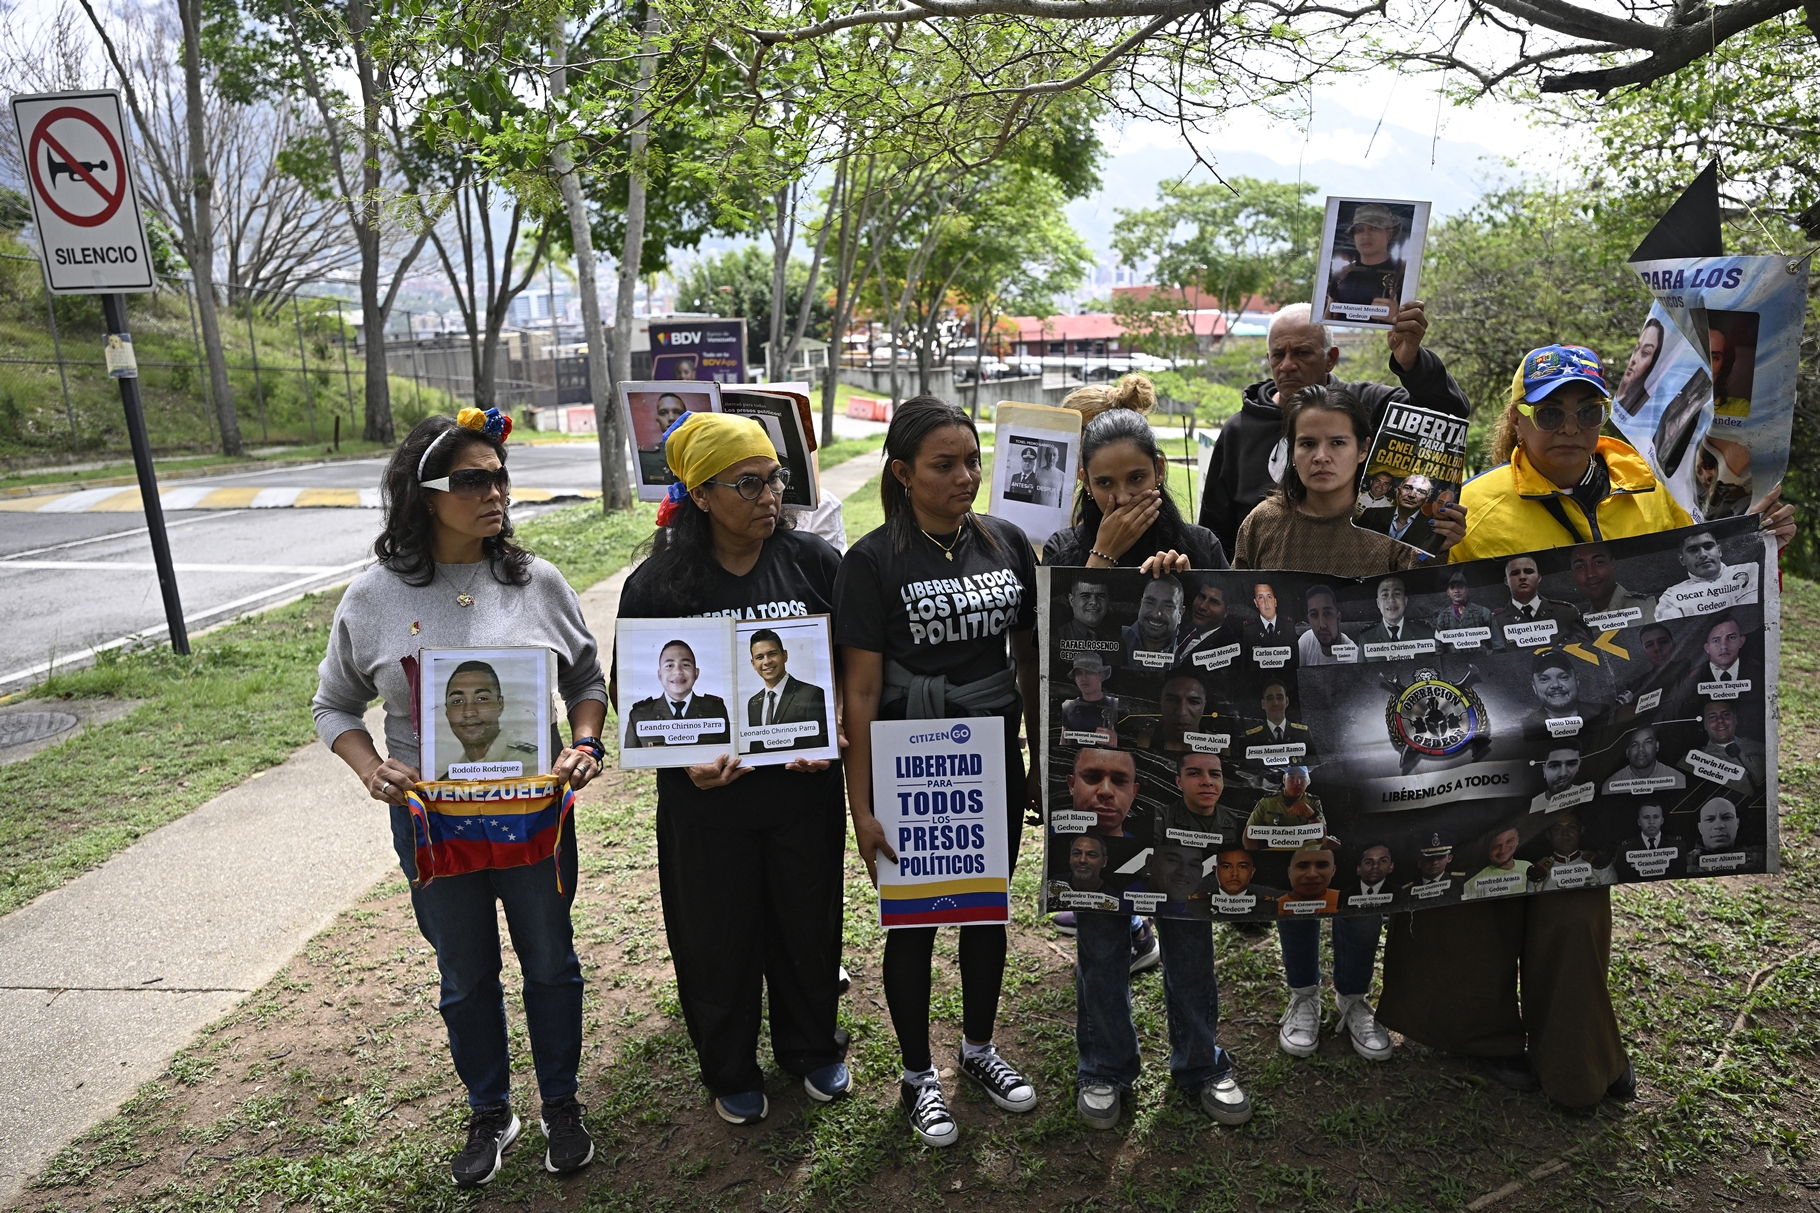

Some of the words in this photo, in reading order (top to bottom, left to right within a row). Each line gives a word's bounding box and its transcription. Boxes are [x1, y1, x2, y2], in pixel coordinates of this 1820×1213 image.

[55, 246, 138, 265] SILENCIO
[1641, 269, 1685, 290] PARA
[1690, 268, 1743, 289] LOS
[671, 331, 702, 345] BDV
[1386, 408, 1468, 447] LIBERTA
[1419, 437, 1445, 453] PARA
[1376, 449, 1421, 474] GARCÍA
[1417, 448, 1463, 469] OSWALDO
[901, 578, 963, 603] LIBEREN
[963, 576, 977, 591] A
[1676, 590, 1704, 601] Oscar
[1706, 584, 1740, 598] Aguillon
[906, 595, 951, 621] LOS
[951, 584, 1023, 614] PRESOS
[1697, 600, 1727, 612] Gedeon
[745, 607, 757, 619] A
[757, 600, 808, 618] TODOS
[1584, 614, 1608, 623] Rodolfo
[1507, 626, 1533, 636] Miguel
[1534, 623, 1554, 631] Plaza
[1602, 621, 1625, 629] Gedeon
[1060, 639, 1086, 650] RAFAEL
[1086, 640, 1120, 651] ROSENDO
[1457, 639, 1478, 647] Gedeon
[1519, 636, 1547, 644] Gedeon
[1366, 645, 1389, 653] Leandro
[1390, 643, 1416, 651] Chirinos
[1194, 651, 1216, 662] Rosmel
[1208, 658, 1229, 669] Gedeon
[1700, 683, 1724, 691] Jackson
[1725, 681, 1749, 690] Taquiva
[1404, 686, 1461, 711] OPERACION
[639, 723, 670, 731] Leandro
[671, 722, 702, 730] Chirinos
[702, 721, 722, 729] Parra
[739, 728, 770, 738] Leonardo
[771, 727, 798, 735] Chirinos
[799, 725, 816, 733] Parra
[668, 733, 695, 742] Gedeon
[766, 737, 792, 746] Gedeon
[1186, 734, 1207, 743] Cosme
[1208, 736, 1228, 744] Alcalá
[1194, 744, 1219, 752] Gedeon
[1263, 746, 1285, 754] Manuel
[452, 765, 481, 774] Rodolfo
[895, 753, 983, 779] LIBERTAD
[1690, 753, 1718, 768] Darwin
[1718, 762, 1740, 775] Herde
[927, 779, 953, 788] PARA
[1381, 782, 1453, 803] LIBÉRENLOS
[1454, 779, 1464, 791] A
[1464, 773, 1510, 788] TODOS
[423, 781, 555, 802] VENEZUELA
[1552, 790, 1579, 803] Jefferson
[897, 789, 984, 816] TODOS
[1558, 797, 1581, 808] Gedeon
[932, 815, 951, 824] LOS
[1051, 813, 1069, 821] afael
[1168, 830, 1193, 838] Jonathan
[1250, 828, 1270, 836] Jesus
[1271, 828, 1296, 836] Rafael
[1297, 827, 1321, 835] Ramos
[898, 824, 985, 852] PRESOS
[1271, 838, 1300, 846] Gedeon
[1653, 850, 1676, 858] Enrique
[1719, 854, 1744, 862] Altamar
[900, 852, 985, 877] POLÍTICOS
[1637, 858, 1668, 867] Granadillo
[1553, 868, 1573, 877] Junior
[1560, 877, 1583, 885] Gedeon
[1213, 896, 1227, 904] José
